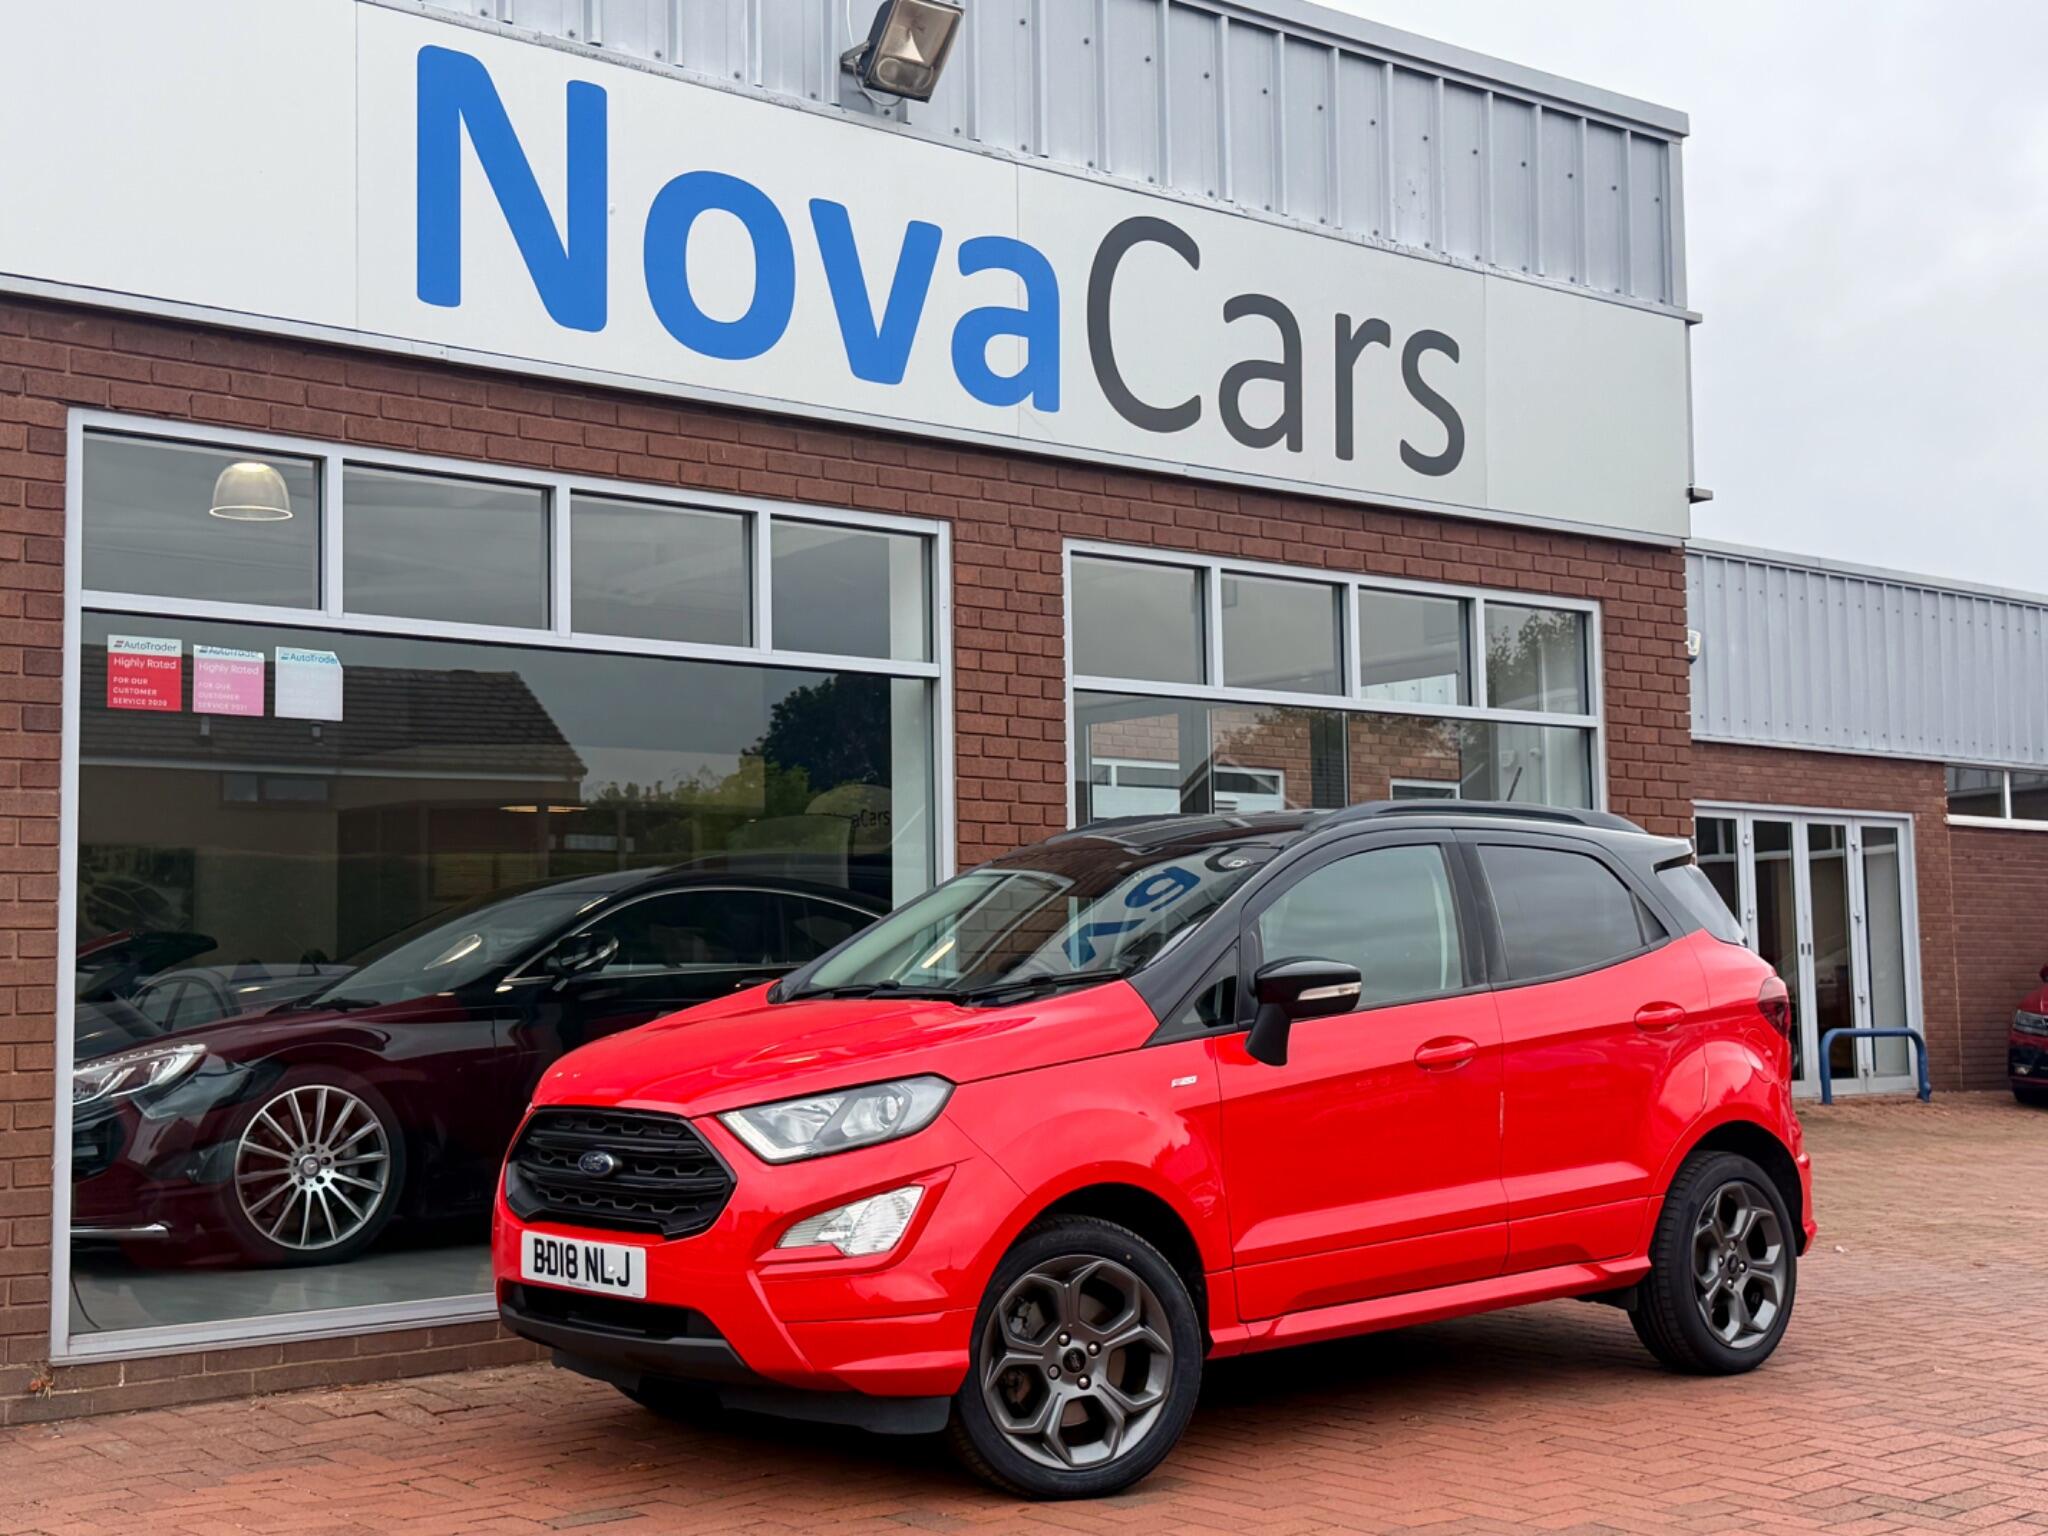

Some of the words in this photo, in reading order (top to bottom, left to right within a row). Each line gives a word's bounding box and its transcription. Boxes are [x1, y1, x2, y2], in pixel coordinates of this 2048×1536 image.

[417, 45, 1465, 476] NovaCars
[124, 640, 177, 652] AutoTrader
[113, 656, 145, 669] Highly
[147, 658, 177, 669] Rated
[290, 653, 337, 665] AutoTrade
[199, 663, 229, 674] Highly
[230, 665, 259, 675] Rated
[113, 676, 129, 684] FOR
[131, 677, 148, 685] OUR
[112, 686, 158, 696] CUSTOMER
[112, 697, 146, 705] SERVICE
[533, 1238, 578, 1279] BD18
[585, 1245, 630, 1287] NLJ
